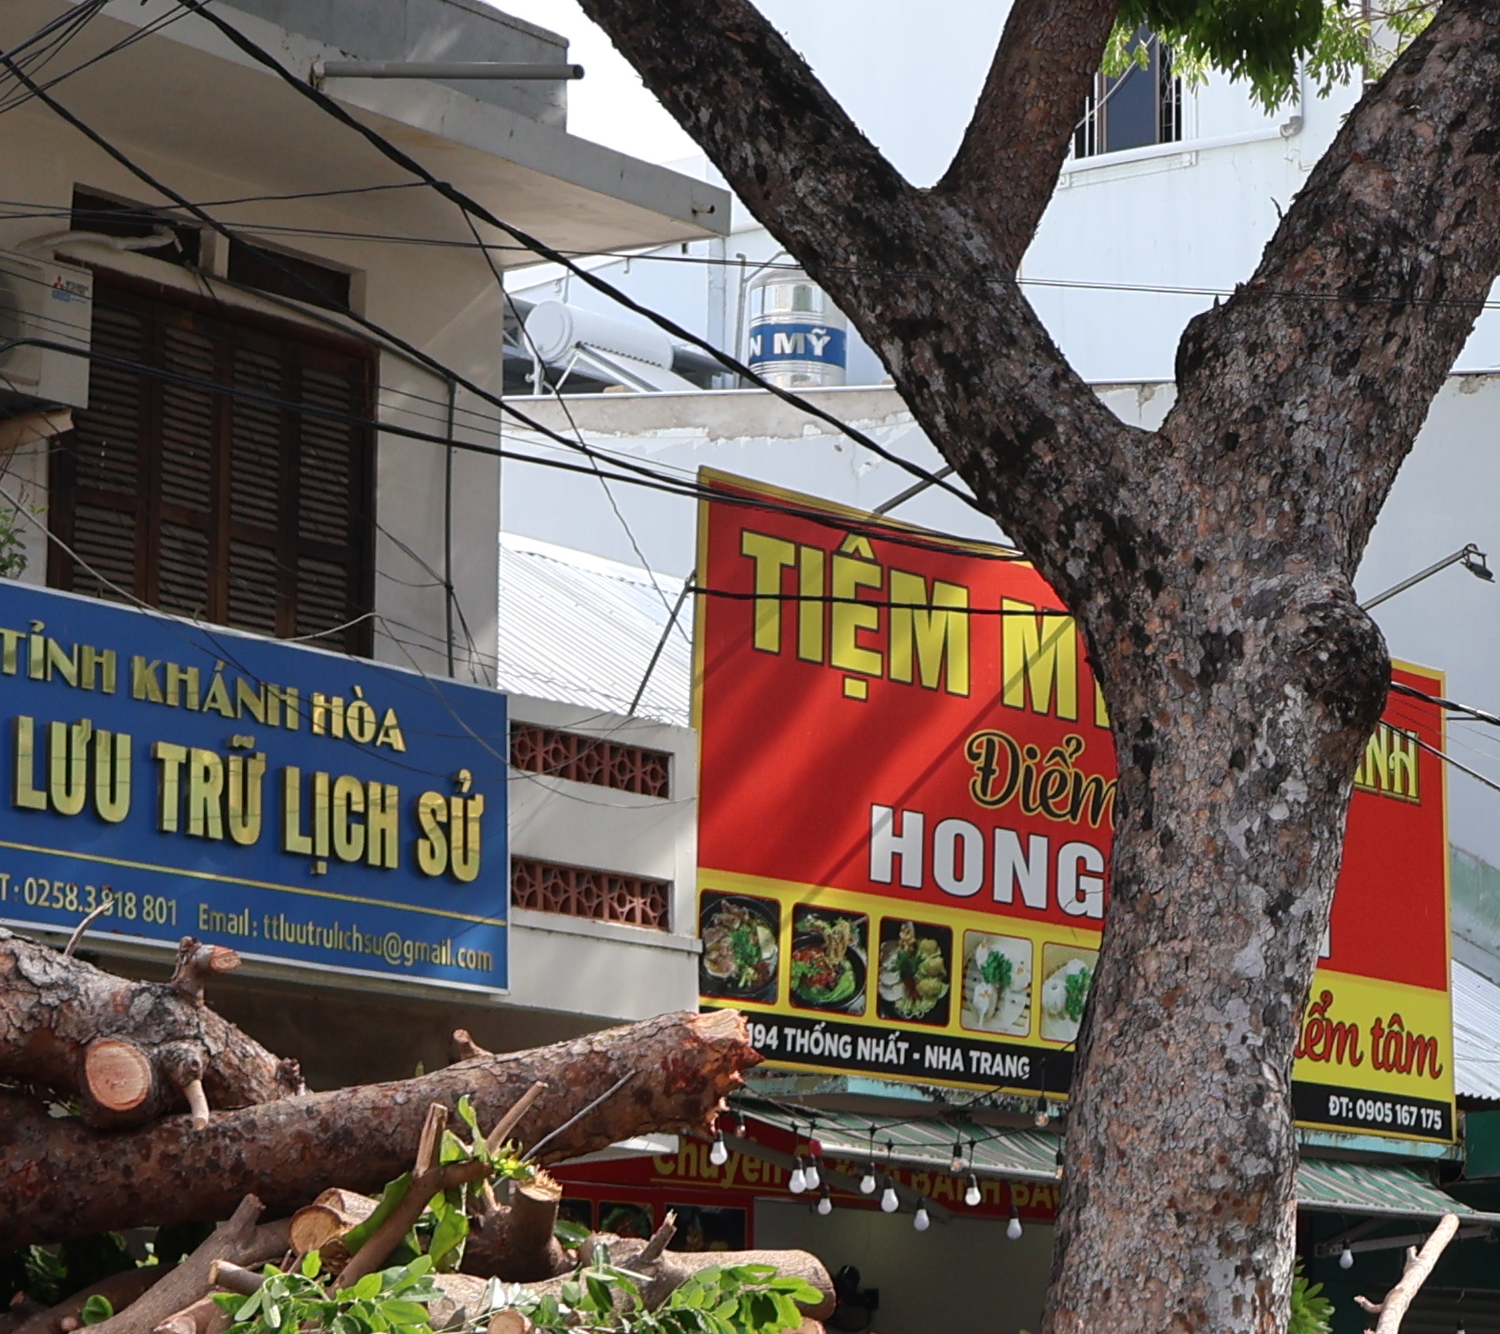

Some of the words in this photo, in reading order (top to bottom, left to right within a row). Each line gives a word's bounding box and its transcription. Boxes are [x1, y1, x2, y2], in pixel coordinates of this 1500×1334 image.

[773, 328, 831, 356] MỸ
[740, 530, 971, 701] TIỆM
[131, 660, 299, 730] KHÁNH
[311, 685, 406, 752] HÒA
[11, 715, 131, 824] LƯU
[151, 734, 266, 846] TRỮ
[281, 765, 399, 876] LỊCH
[416, 768, 485, 883] SỬ
[784, 1022, 852, 1059] THỐNG
[856, 1031, 910, 1065] NHẤT
[925, 1045, 965, 1072] NHA
[969, 1050, 1030, 1080] TRANG
[1371, 1013, 1443, 1079] tâm
[1356, 1098, 1392, 1124] 0905
[1395, 1103, 1417, 1127] 167
[1420, 1107, 1442, 1130] 175
